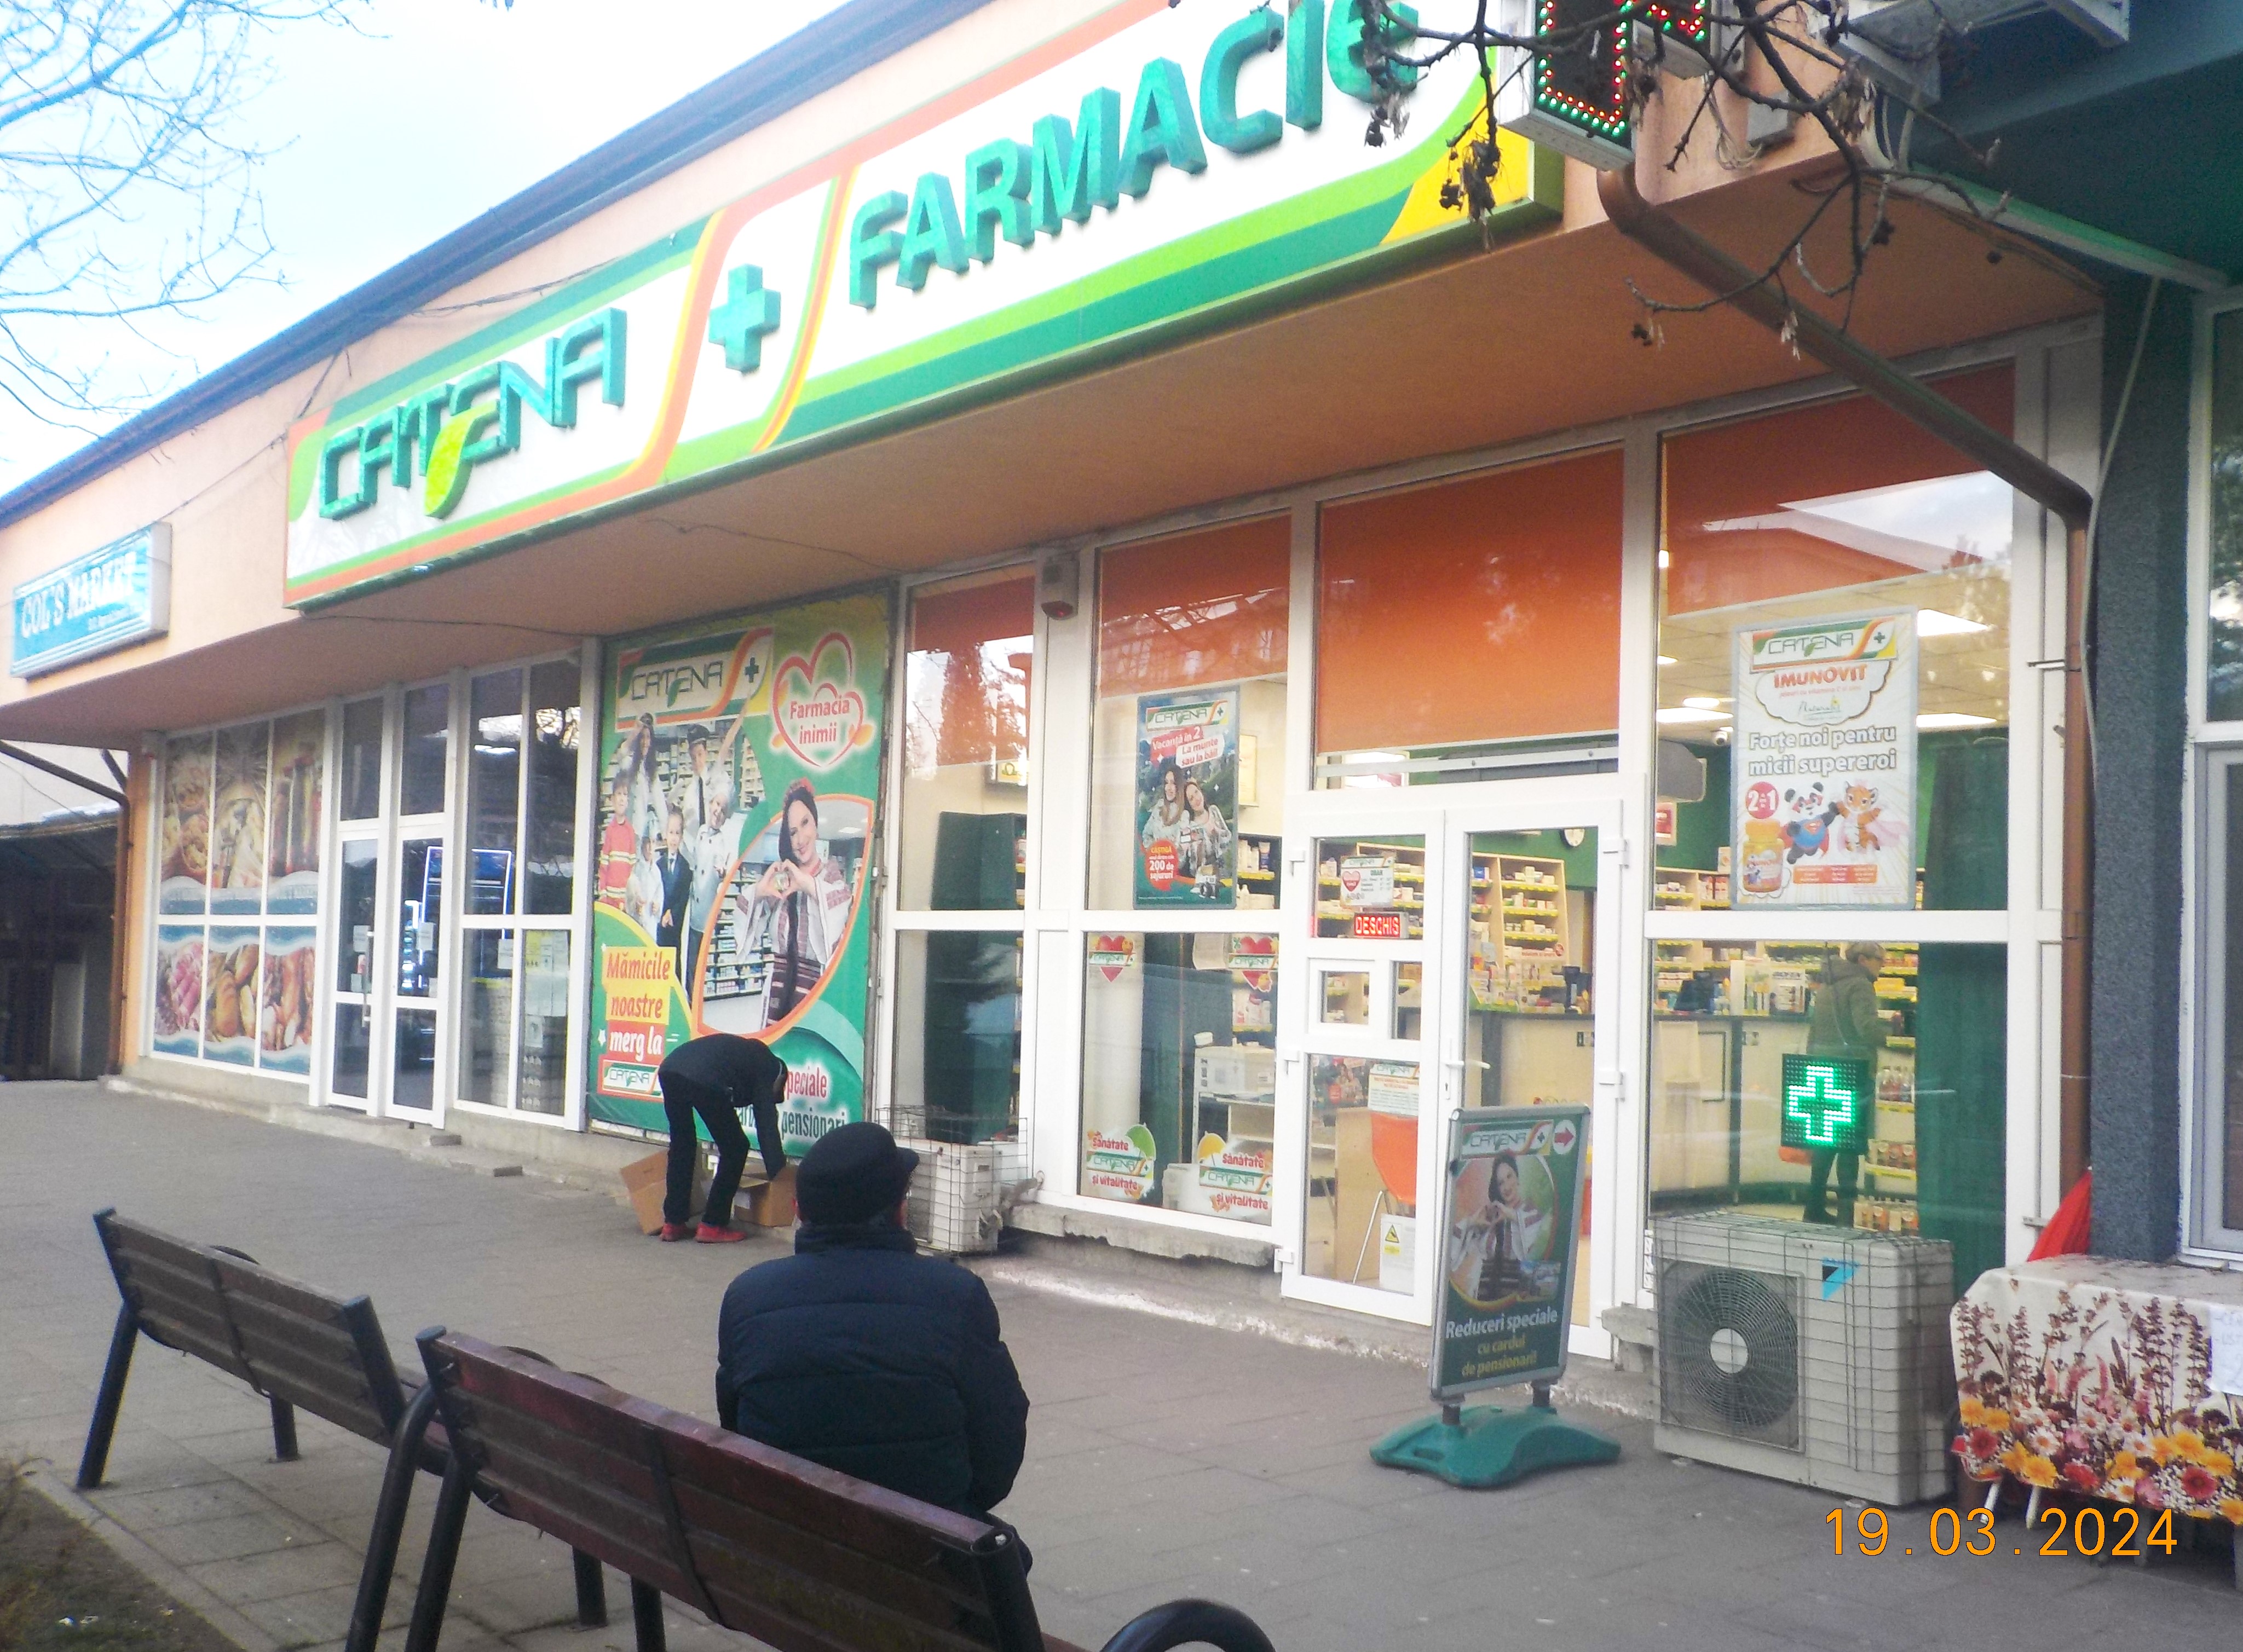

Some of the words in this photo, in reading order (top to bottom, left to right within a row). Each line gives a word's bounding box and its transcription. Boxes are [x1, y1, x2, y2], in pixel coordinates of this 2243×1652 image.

[319, 308, 627, 520] CATENA
[21, 582, 65, 639] COL'S
[1768, 632, 1854, 657] CATENA
[631, 660, 723, 707] CATENA
[1774, 663, 1867, 688] IMUNOVIT
[790, 696, 850, 719] Farmacia
[1155, 708, 1207, 724] CATENA
[799, 724, 837, 744] inimii
[1193, 726, 1201, 740] 2
[1798, 726, 1829, 747] noi
[1831, 725, 1897, 749] pentru
[1749, 754, 1796, 776] micii
[1798, 748, 1897, 777] supereroi
[1149, 859, 1165, 871] 200
[1355, 916, 1399, 935] DESCHIS
[606, 951, 670, 980] Mămicile
[610, 993, 663, 1018] noastre
[609, 1030, 645, 1062] merg
[647, 1025, 662, 1055] la
[609, 1068, 650, 1087] CATENA
[783, 1066, 827, 1100] peciale
[1471, 1132, 1526, 1151] CATENA
[1208, 1172, 1254, 1187] CATENA
[1225, 1193, 1268, 1210] vitalitate
[1445, 1313, 1505, 1339] Reduceri
[1507, 1306, 1558, 1333] speciale
